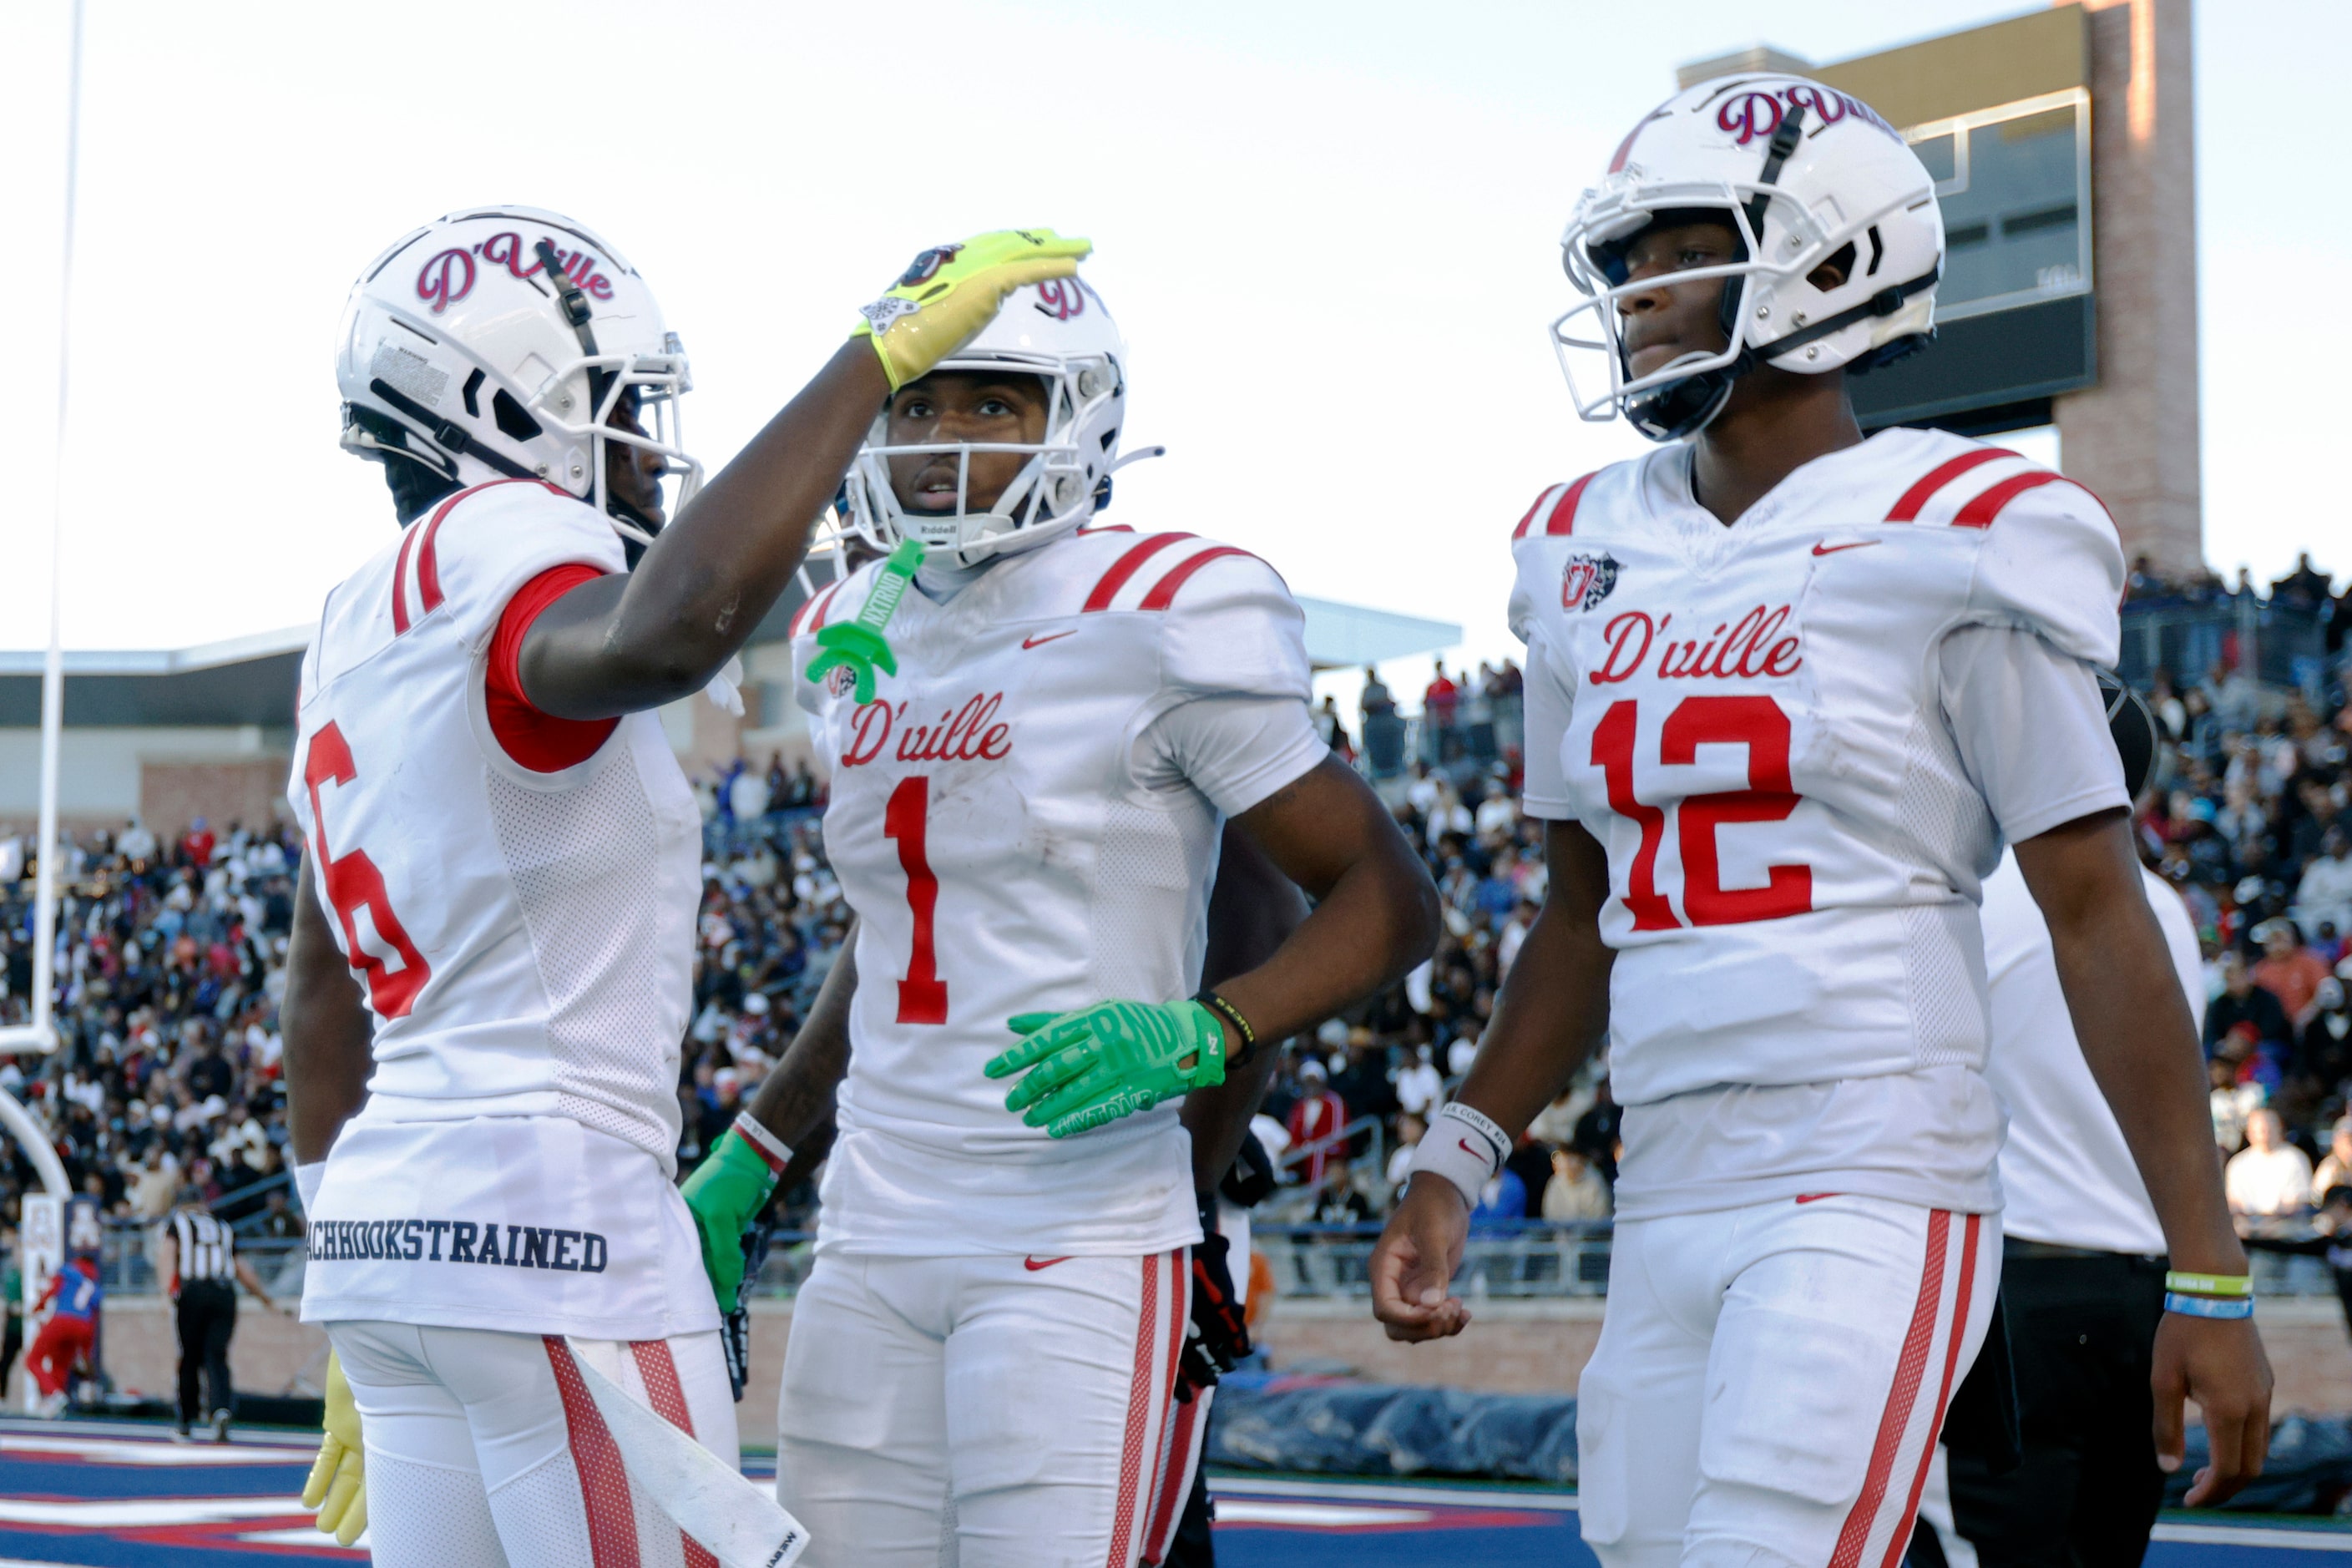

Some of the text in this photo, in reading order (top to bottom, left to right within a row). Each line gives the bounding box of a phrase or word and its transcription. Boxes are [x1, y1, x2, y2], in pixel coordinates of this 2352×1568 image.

[417, 231, 615, 313] D'Vlle
[920, 524, 957, 534] Riddell
[861, 571, 905, 628] NXTRND
[1590, 604, 1803, 685] D'ville
[842, 691, 1012, 768] D'ville
[1590, 695, 1813, 932] 12
[304, 718, 432, 1024] 6
[883, 776, 948, 1025] 1
[1459, 1108, 1493, 1131] COREY
